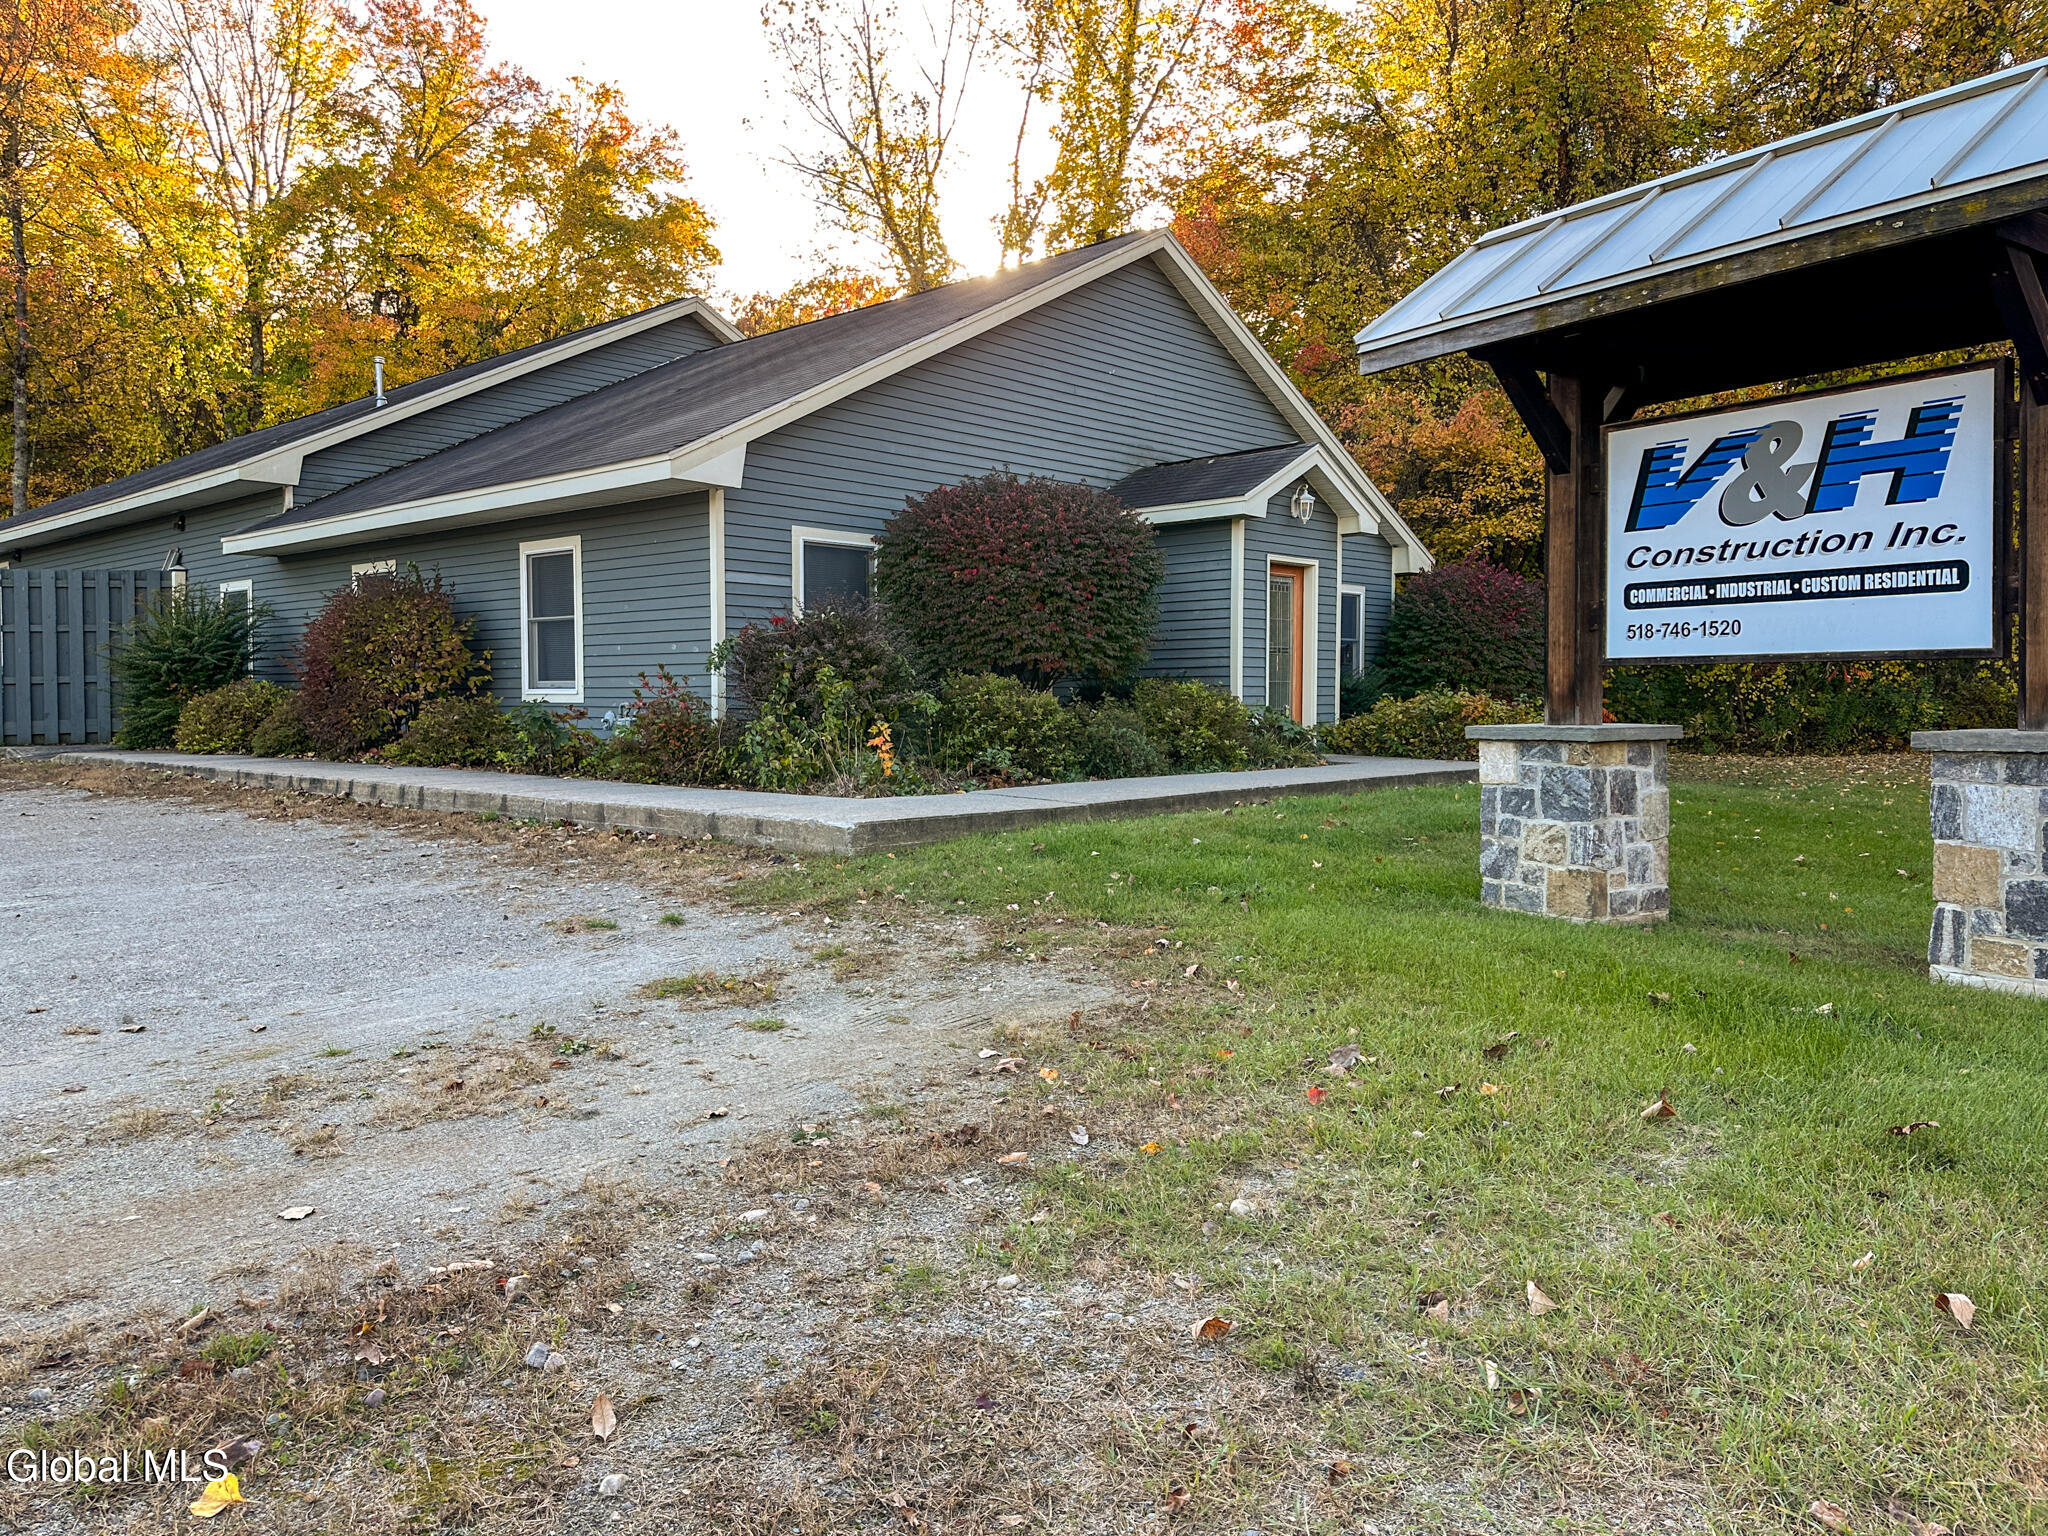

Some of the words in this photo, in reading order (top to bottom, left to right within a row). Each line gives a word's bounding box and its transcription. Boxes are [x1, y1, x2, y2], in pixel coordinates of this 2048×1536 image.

[1624, 395, 1967, 533] V&H
[1626, 526, 1874, 569] Construction
[1887, 521, 1967, 549] Inc.
[1629, 584, 1708, 605] COMMERCIAL
[1715, 579, 1793, 599] INDUSTRIAL
[1801, 574, 1861, 593] CUSTOM
[1864, 567, 1960, 590] RESIDENTIAL
[1626, 619, 1742, 640] 518-746-1520
